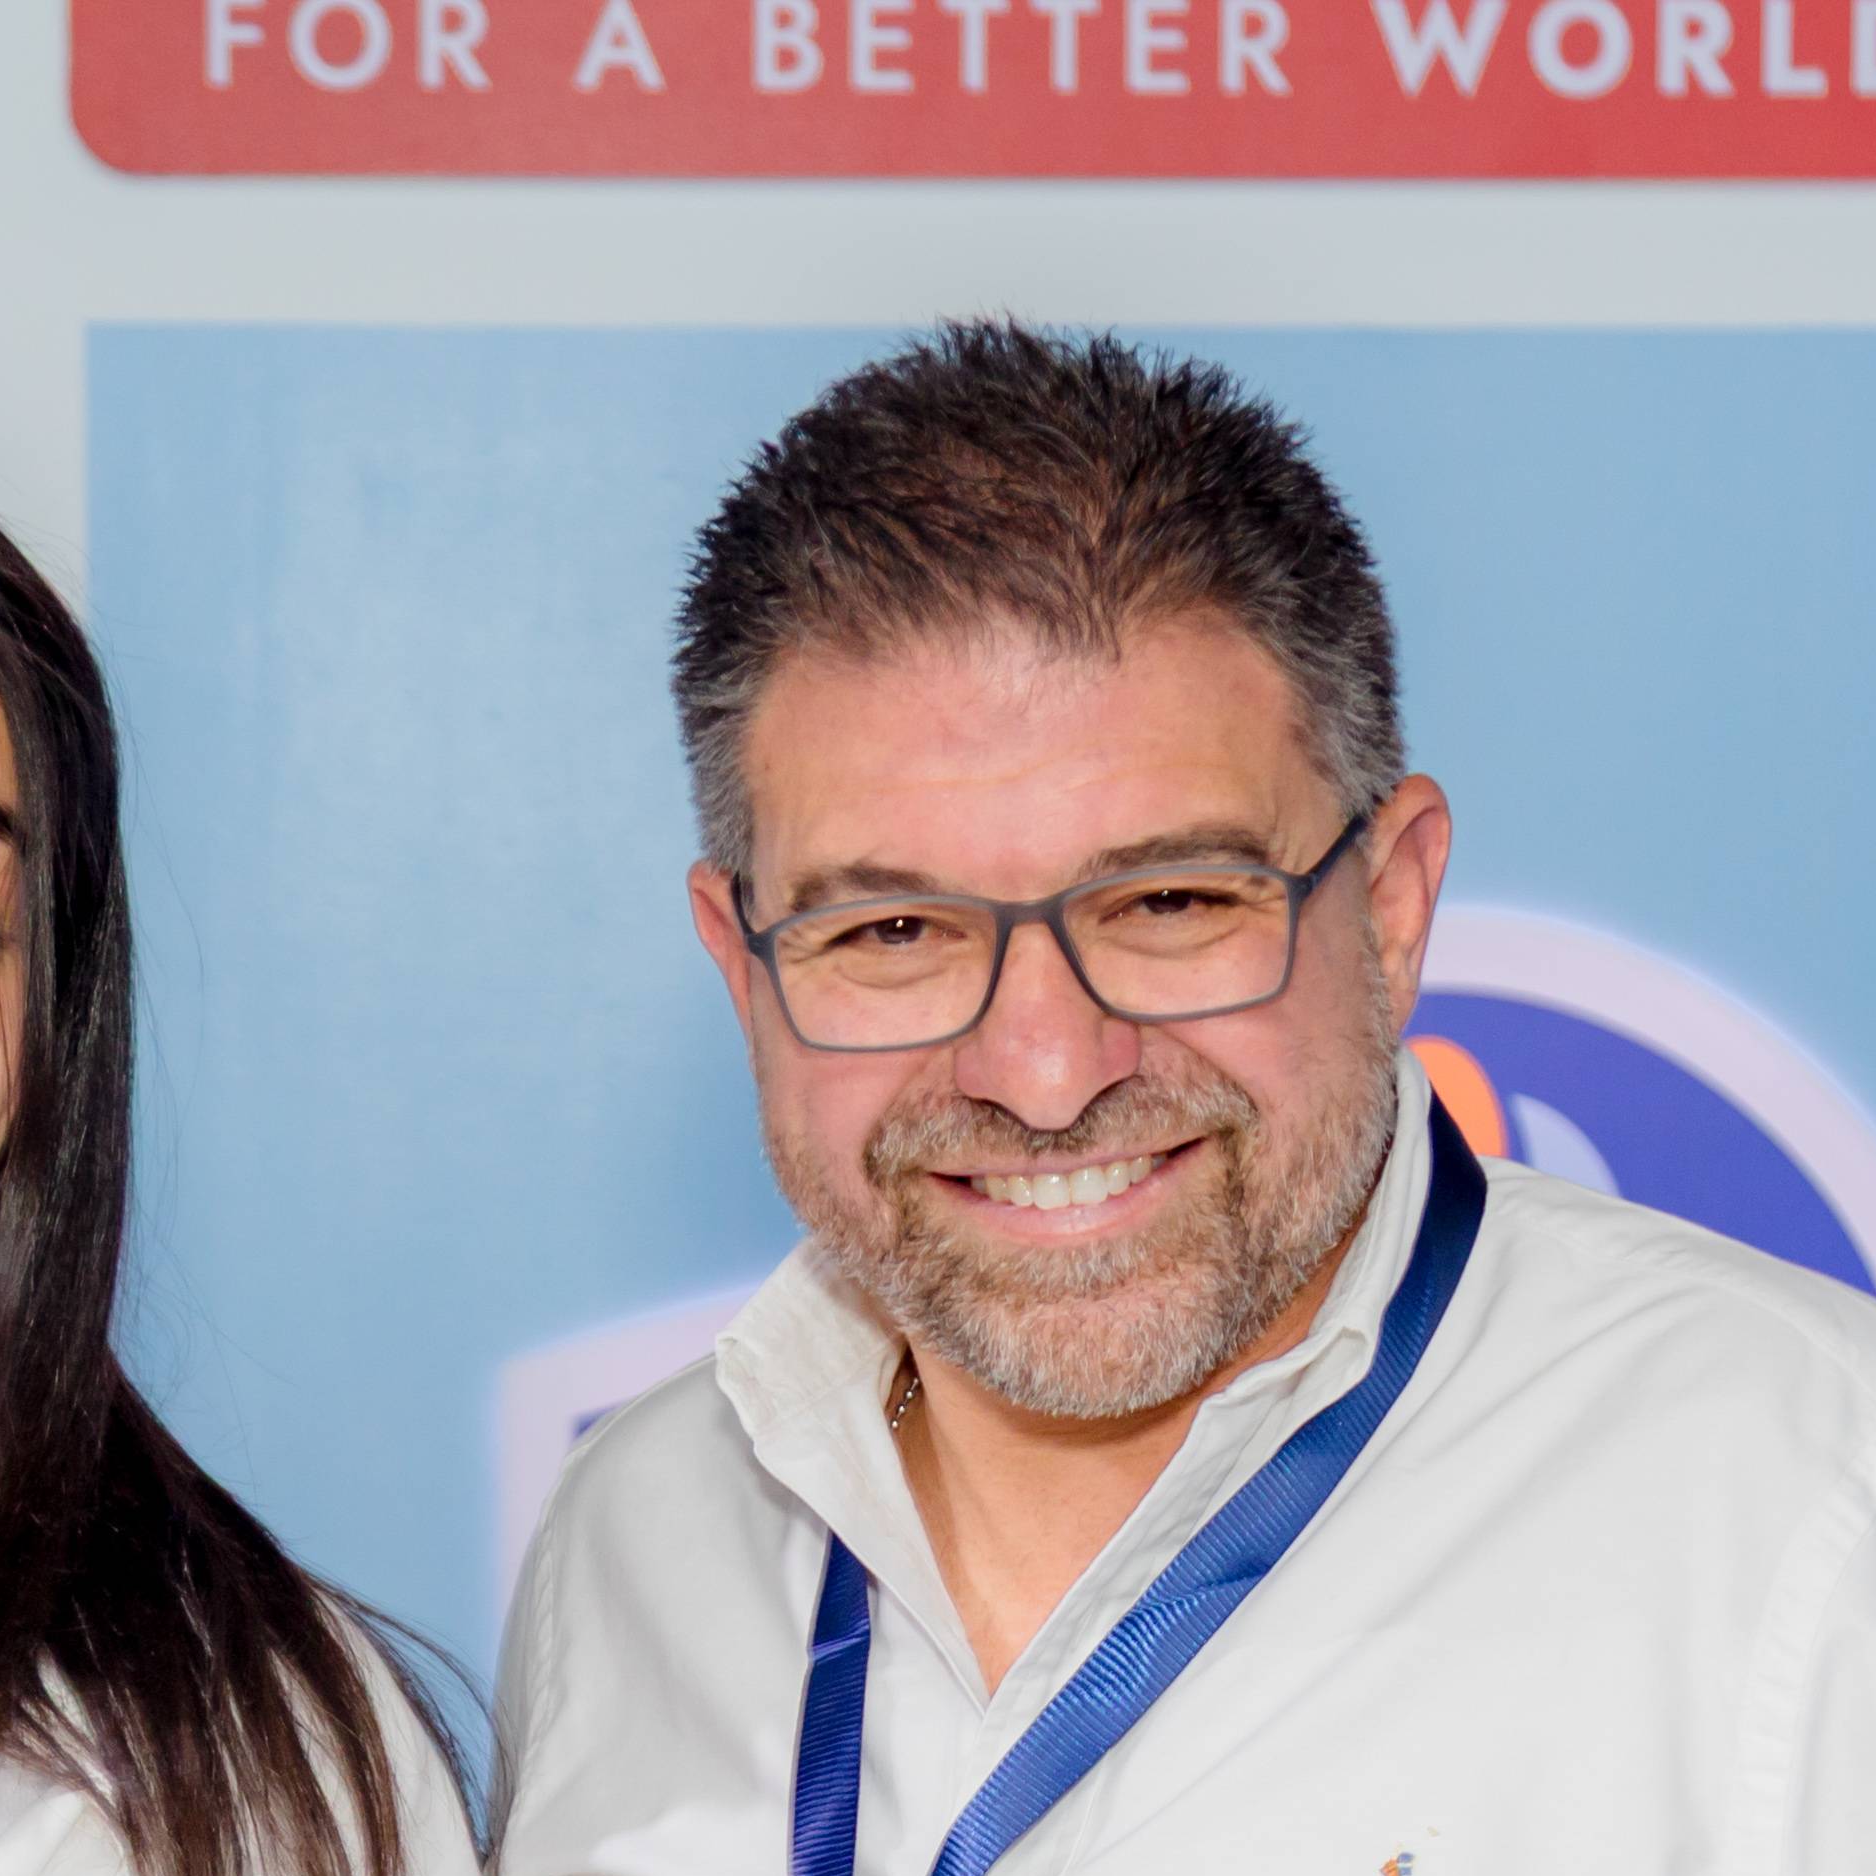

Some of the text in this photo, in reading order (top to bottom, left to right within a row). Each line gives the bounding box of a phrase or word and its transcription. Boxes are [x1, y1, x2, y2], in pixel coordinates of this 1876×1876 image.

[203, 0, 493, 90] FOR
[571, 0, 667, 92] A
[751, 0, 1293, 94] BETTER
